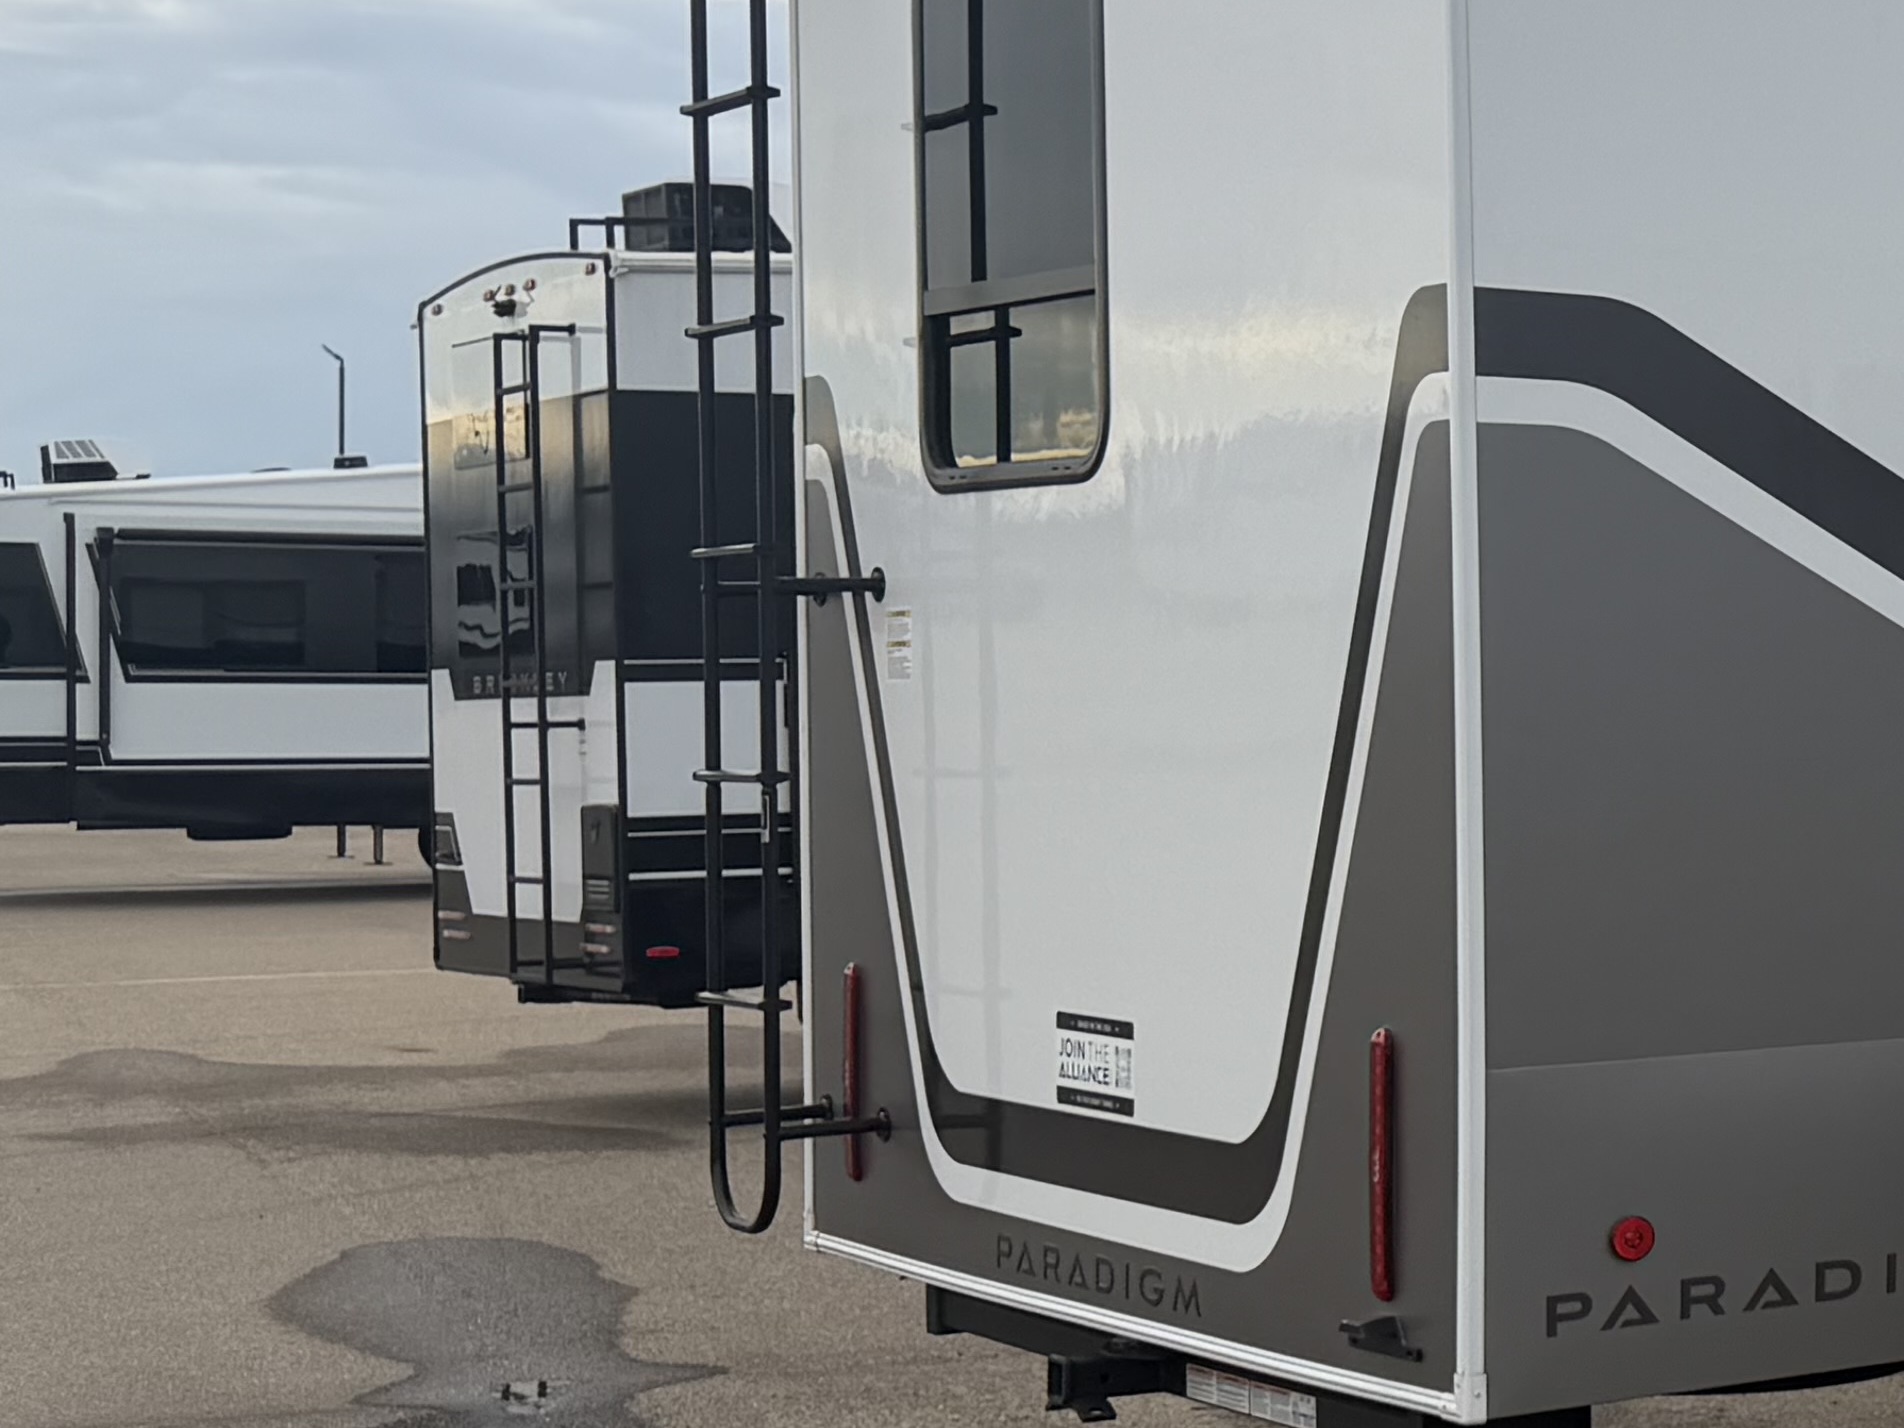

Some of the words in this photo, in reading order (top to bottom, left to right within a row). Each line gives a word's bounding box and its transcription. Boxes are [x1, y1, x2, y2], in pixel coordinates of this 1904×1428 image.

[1059, 1037, 1085, 1060] JOIN
[1088, 1040, 1110, 1064] THE
[996, 1234, 1202, 1318] PARADIGM
